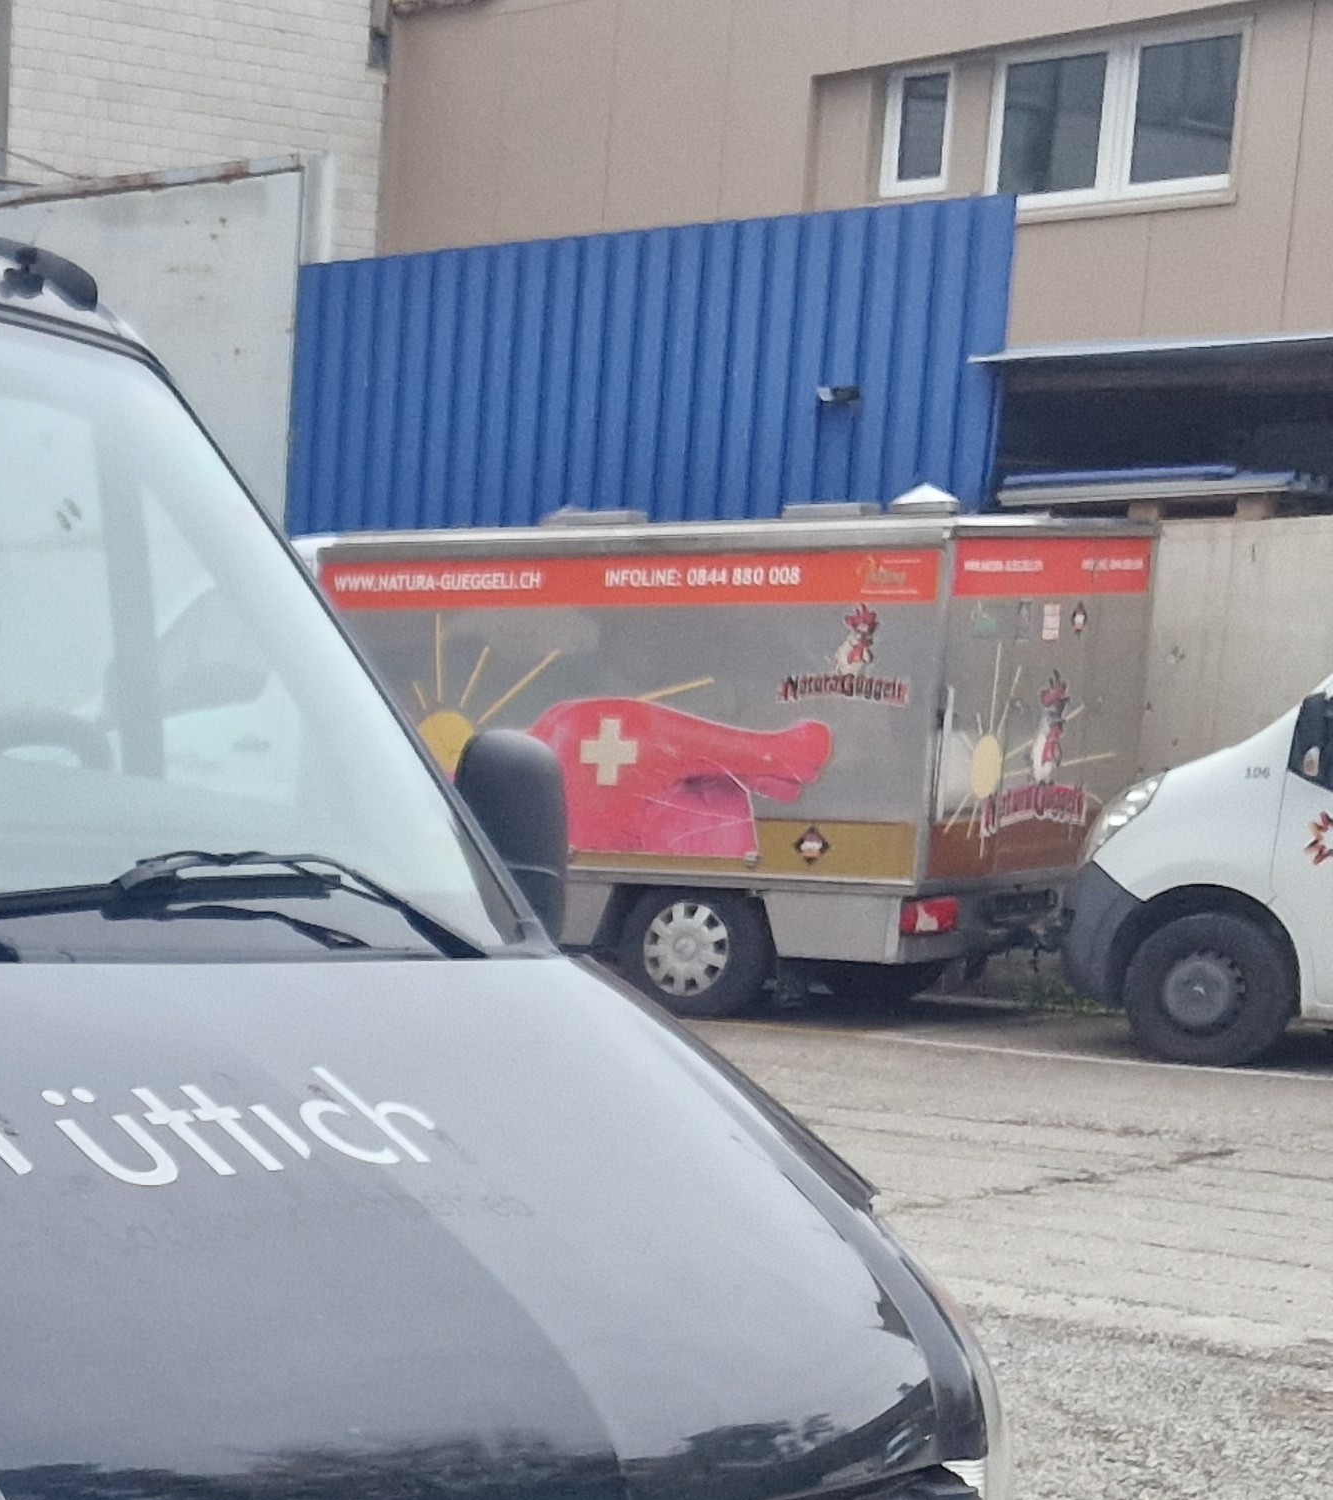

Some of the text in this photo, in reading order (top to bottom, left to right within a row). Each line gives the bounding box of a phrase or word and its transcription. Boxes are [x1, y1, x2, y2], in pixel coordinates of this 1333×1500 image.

[334, 570, 541, 592] WWW.NATURA-GUEGGELI.CH
[604, 565, 801, 588] INFOLINE: 0844 880 008
